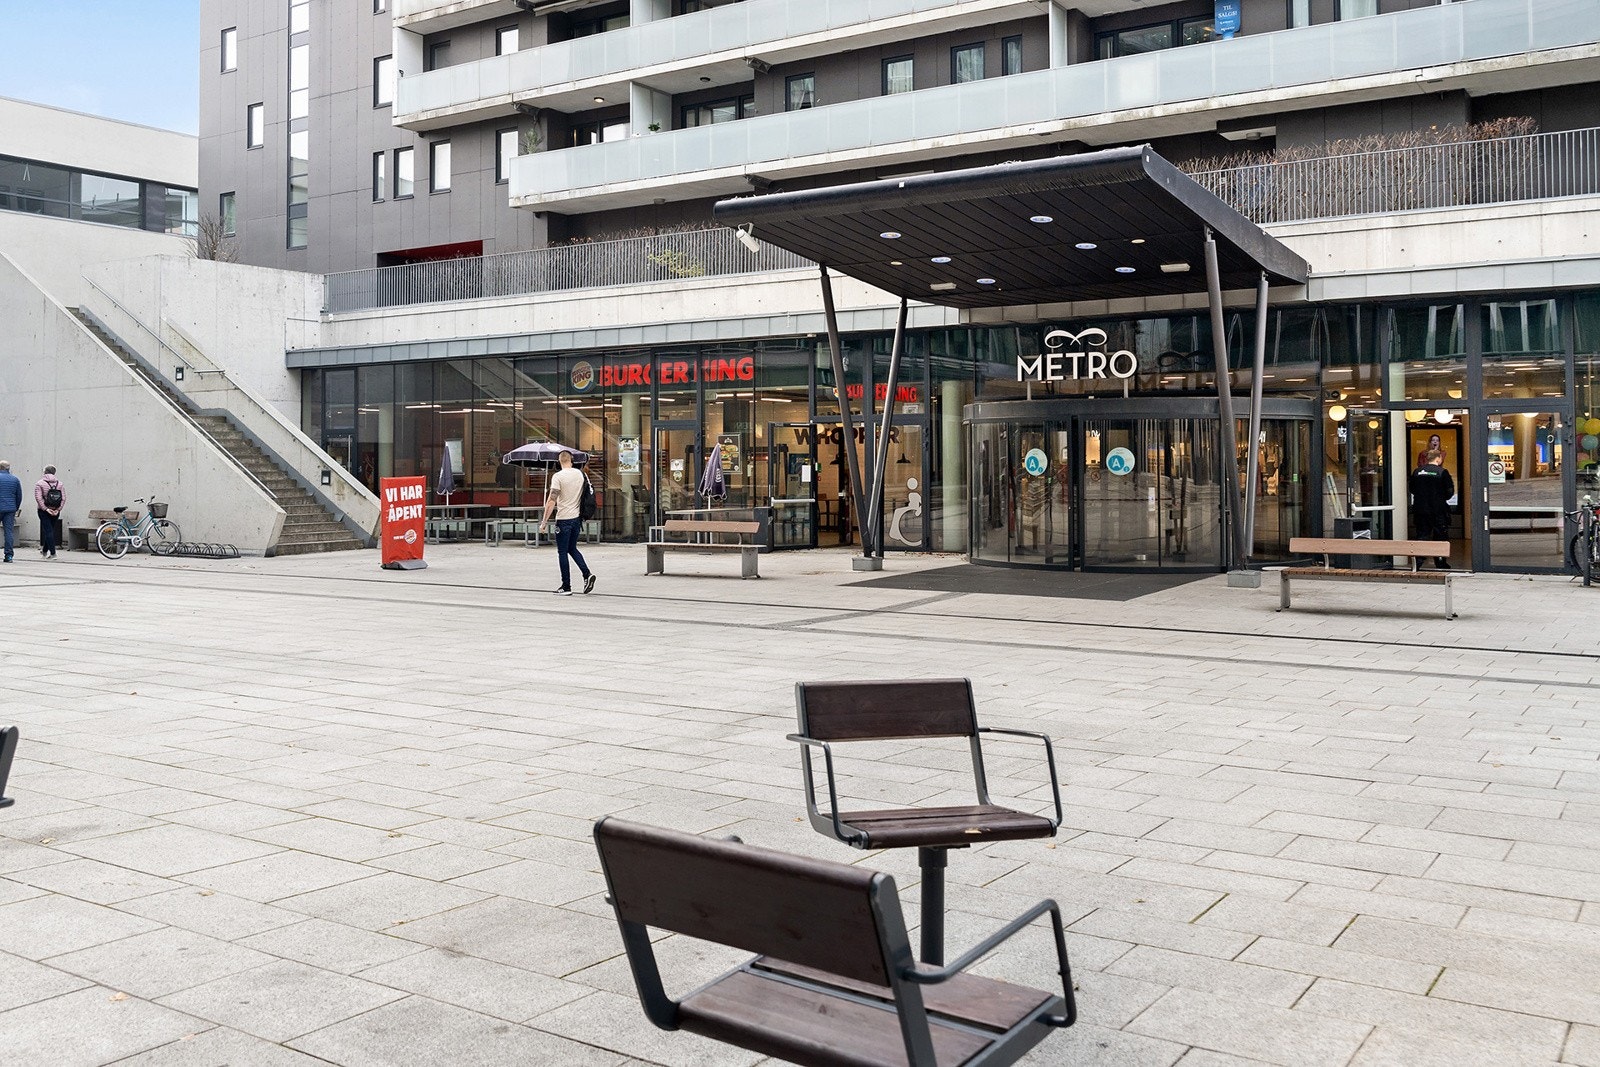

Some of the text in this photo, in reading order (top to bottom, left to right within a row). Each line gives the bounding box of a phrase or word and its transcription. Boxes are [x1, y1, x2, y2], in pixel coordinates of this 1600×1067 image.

[1017, 350, 1137, 382] METRO
[573, 371, 591, 384] KING
[1028, 458, 1037, 469] A
[1111, 457, 1121, 469] A
[385, 484, 423, 503] VI HAR
[387, 503, 423, 523] ÅPENT
